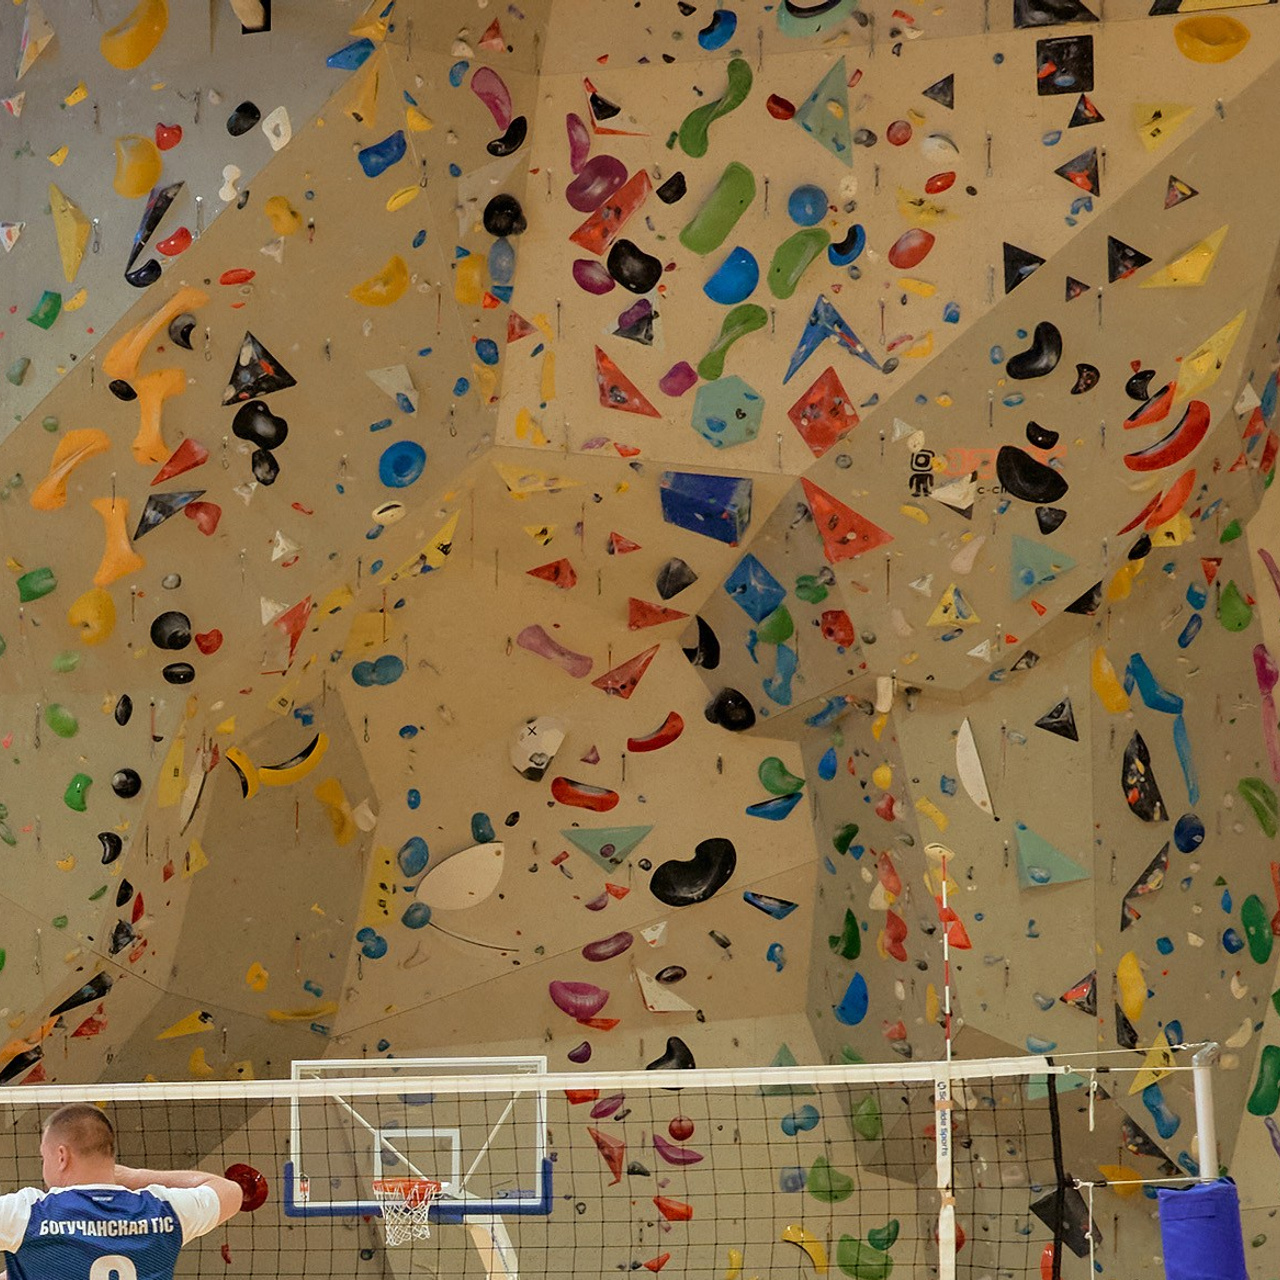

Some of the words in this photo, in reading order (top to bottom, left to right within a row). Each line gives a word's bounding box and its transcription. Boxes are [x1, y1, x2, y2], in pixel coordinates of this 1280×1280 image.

[939, 1091, 947, 1126] Sclde
[939, 1128, 949, 1157] Sports
[39, 1218, 148, 1237] БОГУЧАНСКАЯ
